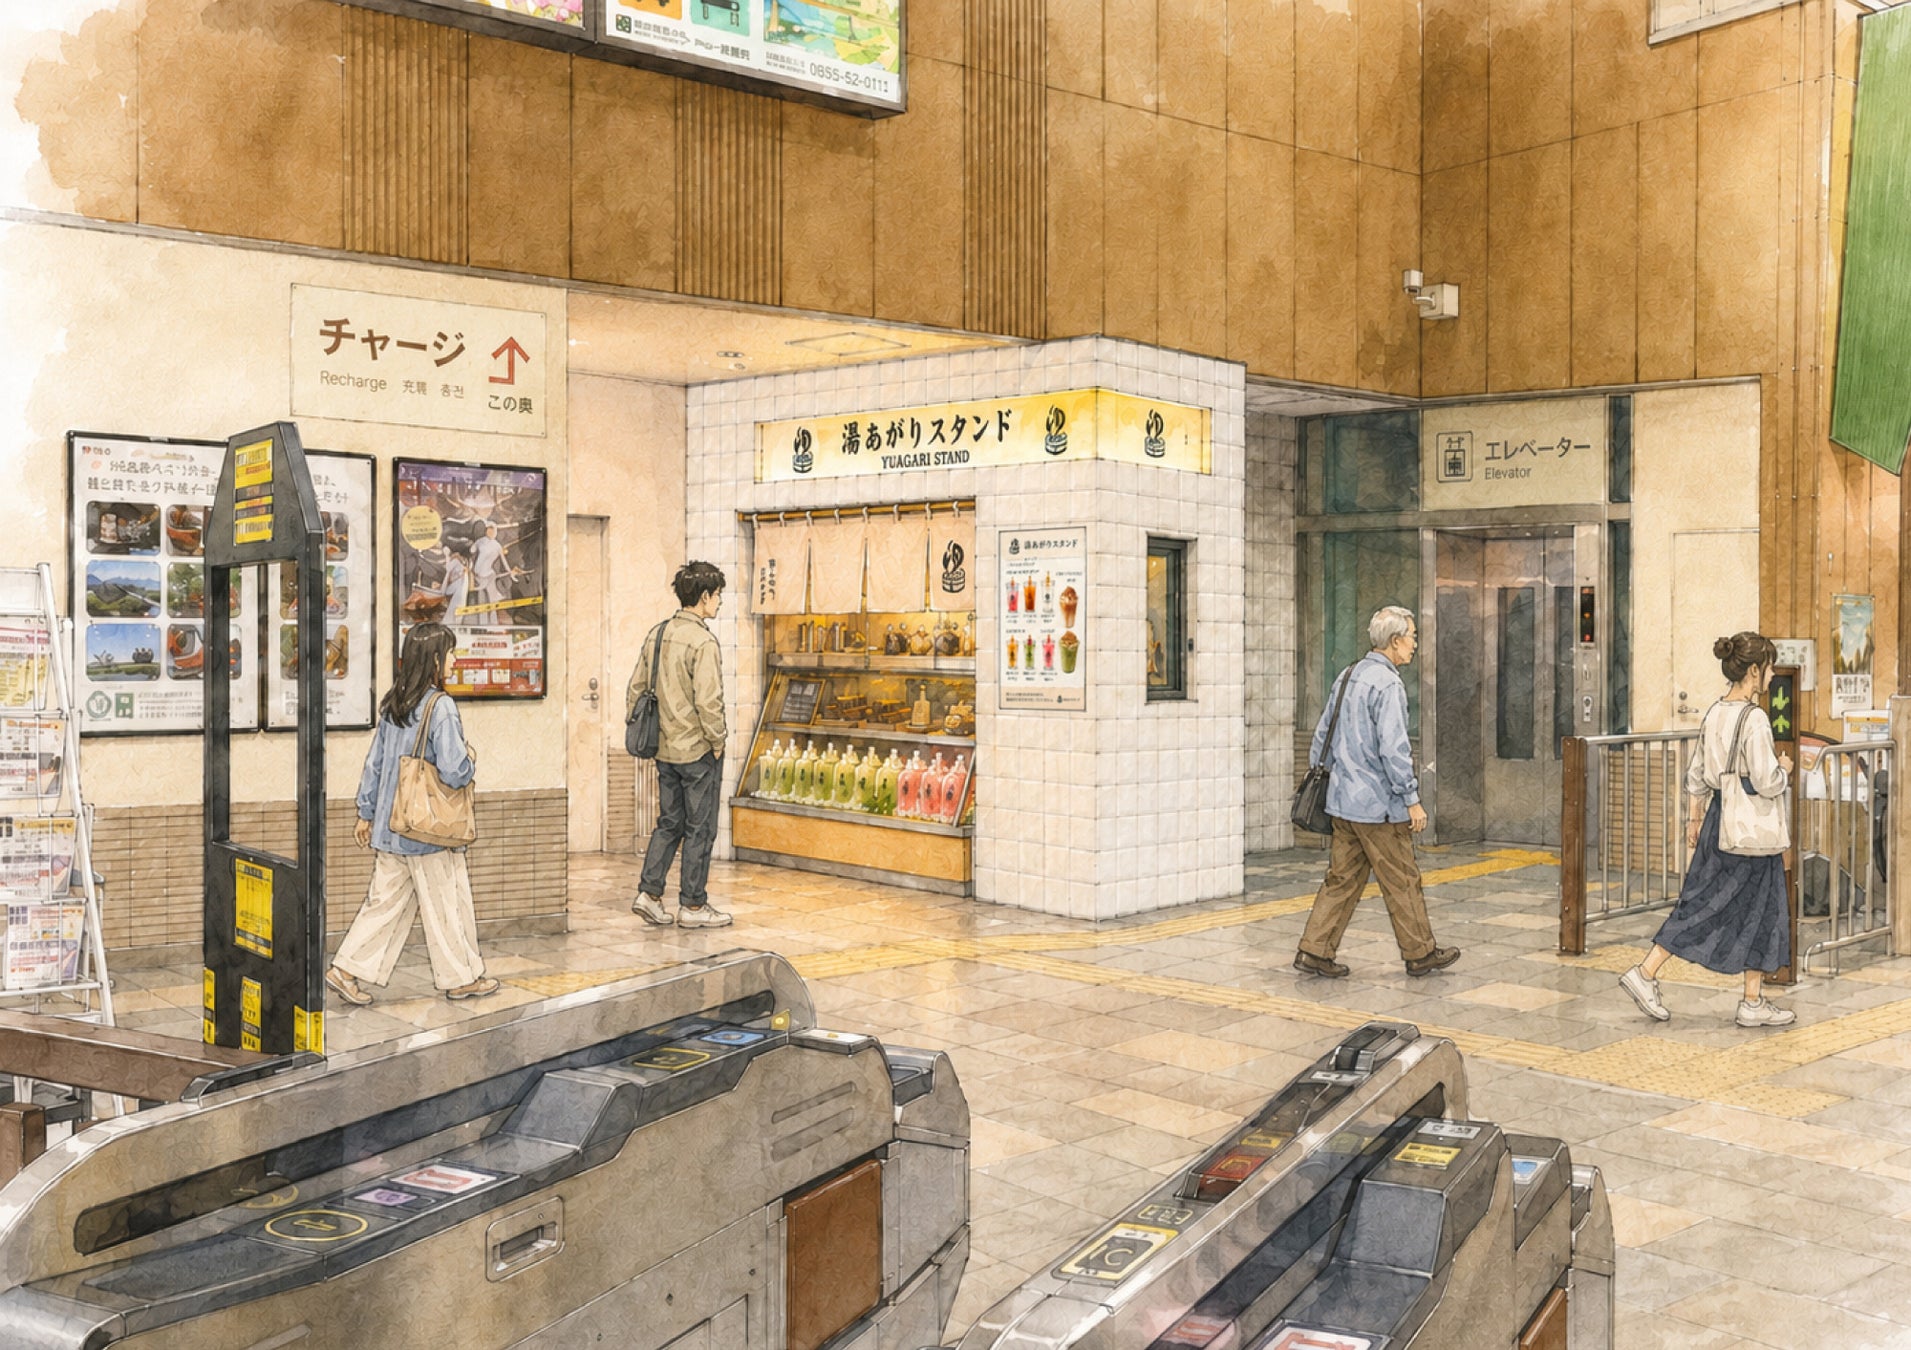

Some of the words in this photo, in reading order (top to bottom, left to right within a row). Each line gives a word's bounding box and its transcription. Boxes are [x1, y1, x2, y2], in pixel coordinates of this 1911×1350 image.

[319, 317, 466, 368] チャージ
[320, 370, 387, 392] Recharge
[488, 394, 533, 414] この奥
[841, 408, 1013, 456] 湯あがりスタンド
[881, 454, 931, 469] YUAGARI
[934, 450, 970, 466] STAND
[1485, 436, 1591, 462] エレベーター
[1484, 466, 1532, 481] Elevator
